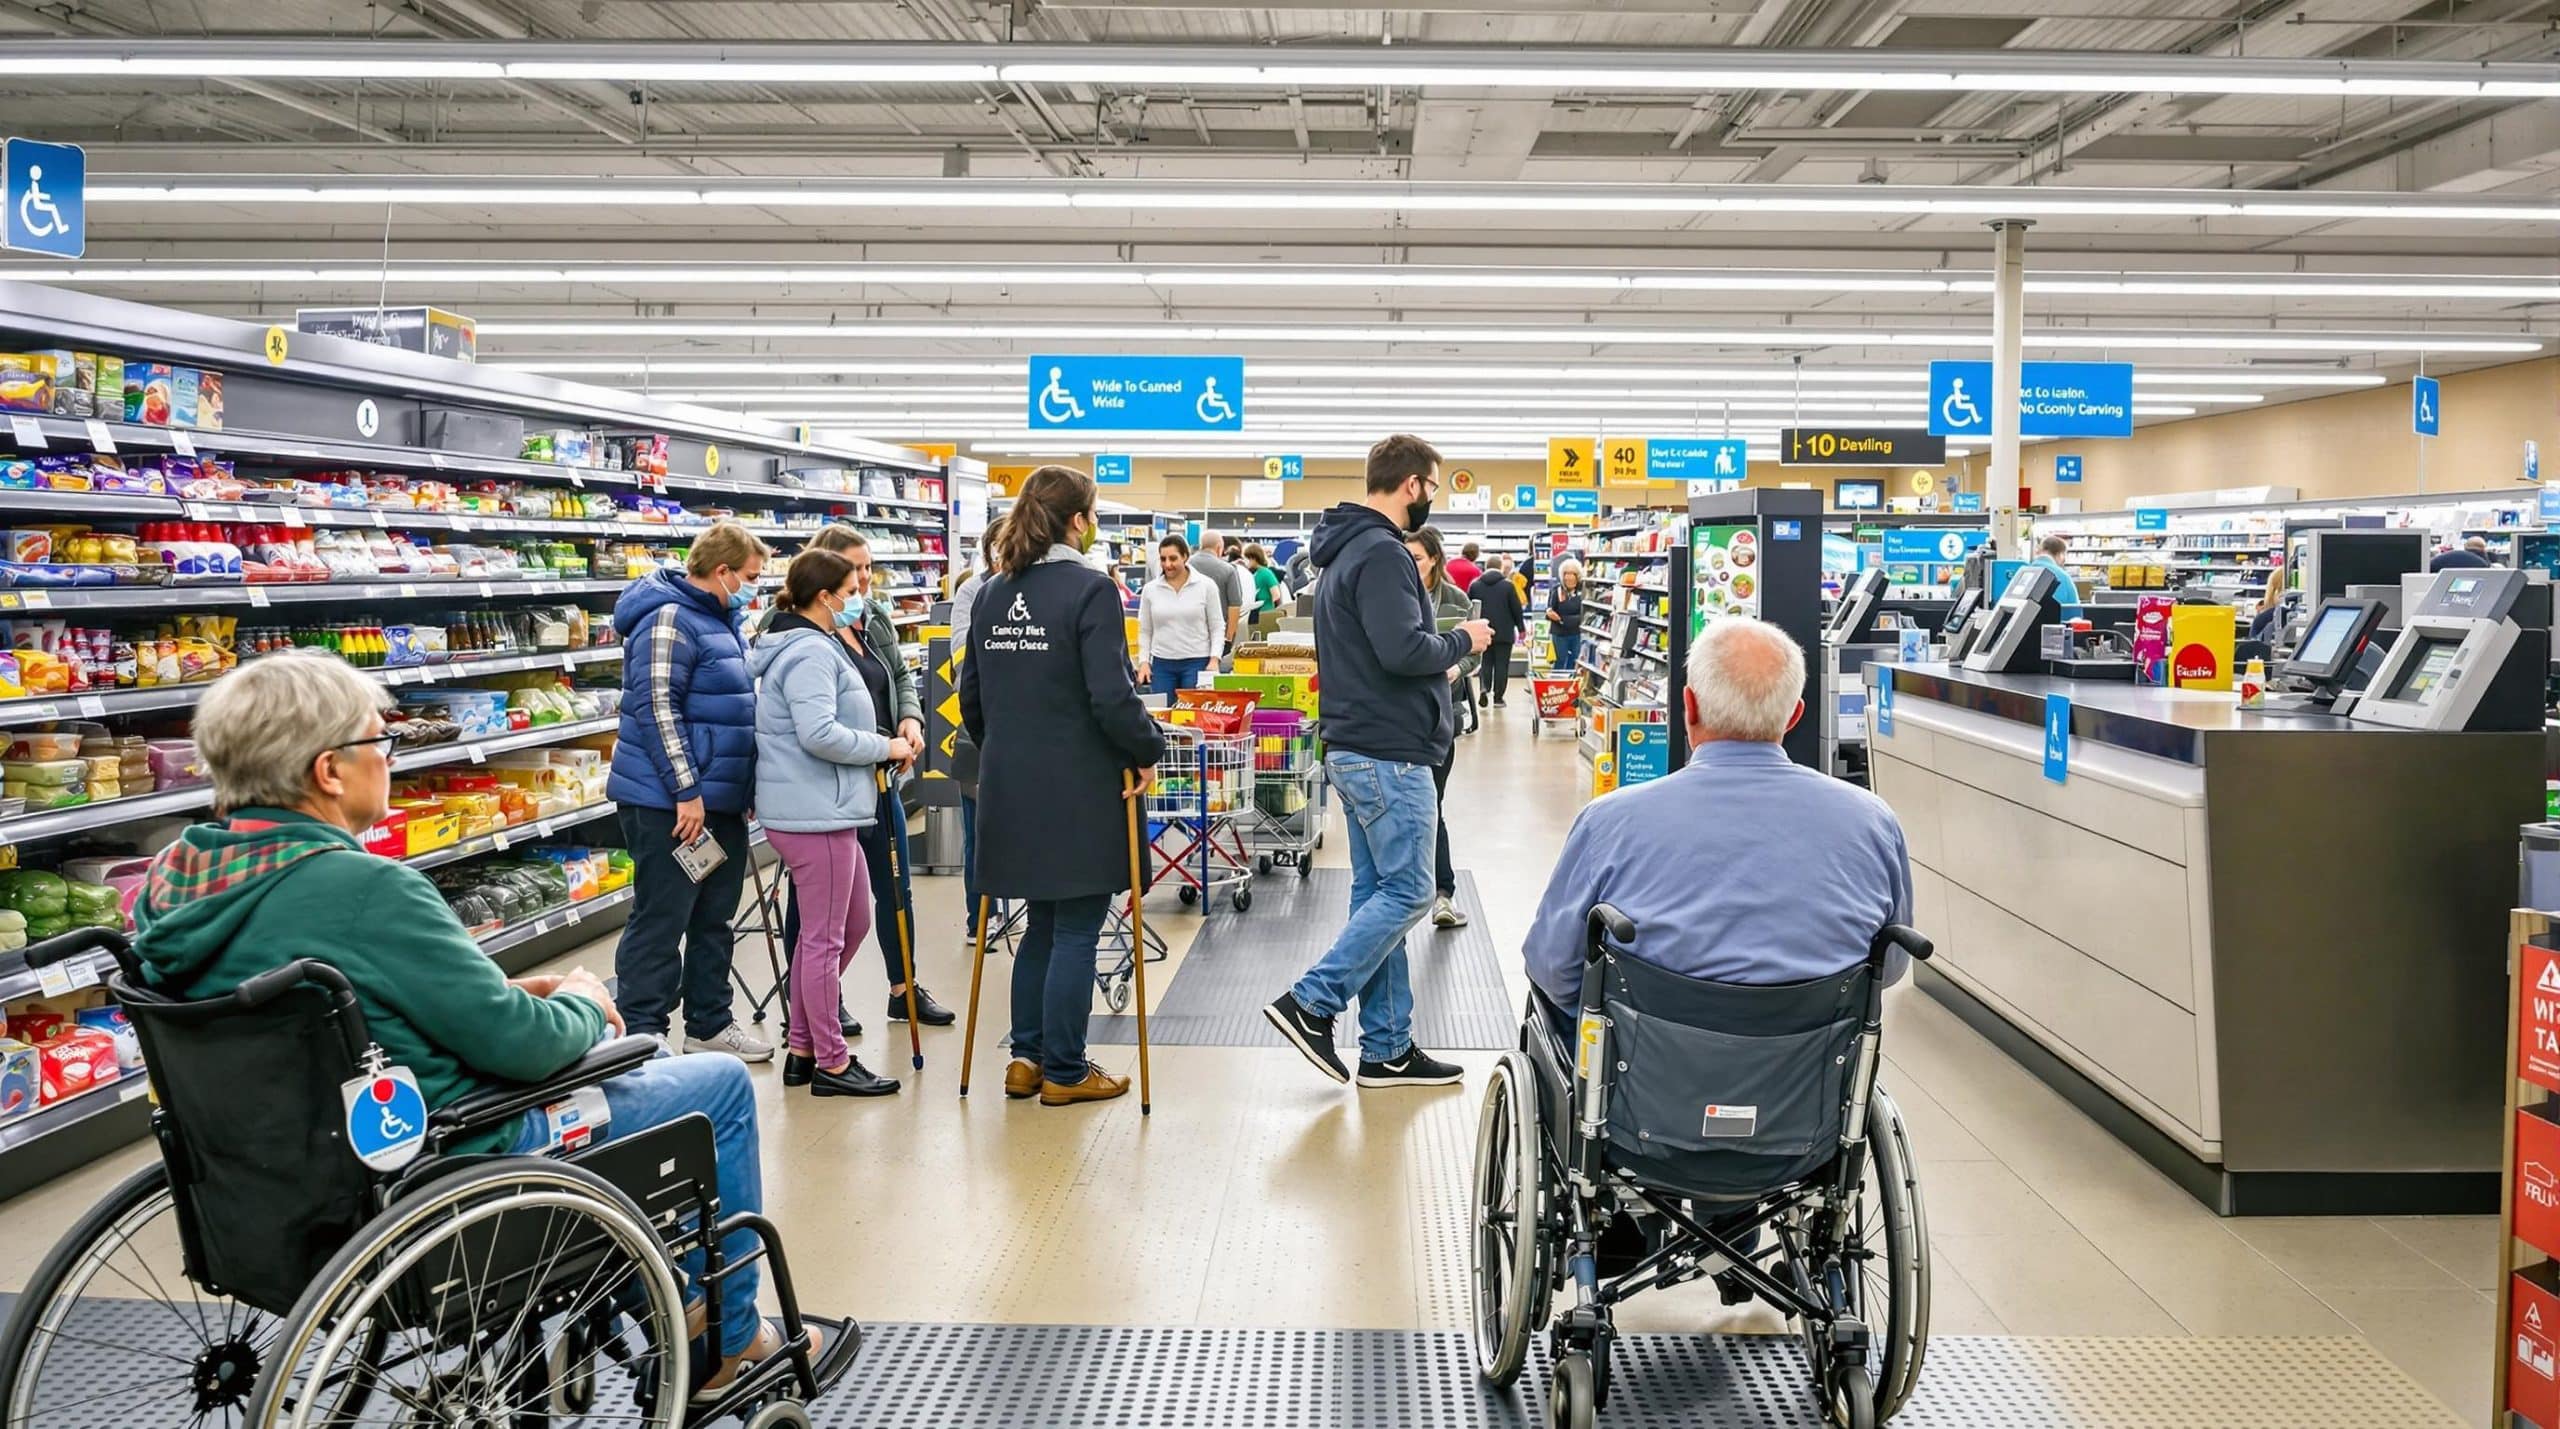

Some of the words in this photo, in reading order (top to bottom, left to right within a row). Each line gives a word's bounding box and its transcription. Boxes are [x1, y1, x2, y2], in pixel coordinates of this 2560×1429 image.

[1092, 380, 1122, 393] Wide
[1806, 433, 1836, 457] 10
[1613, 447, 1635, 464] 40
